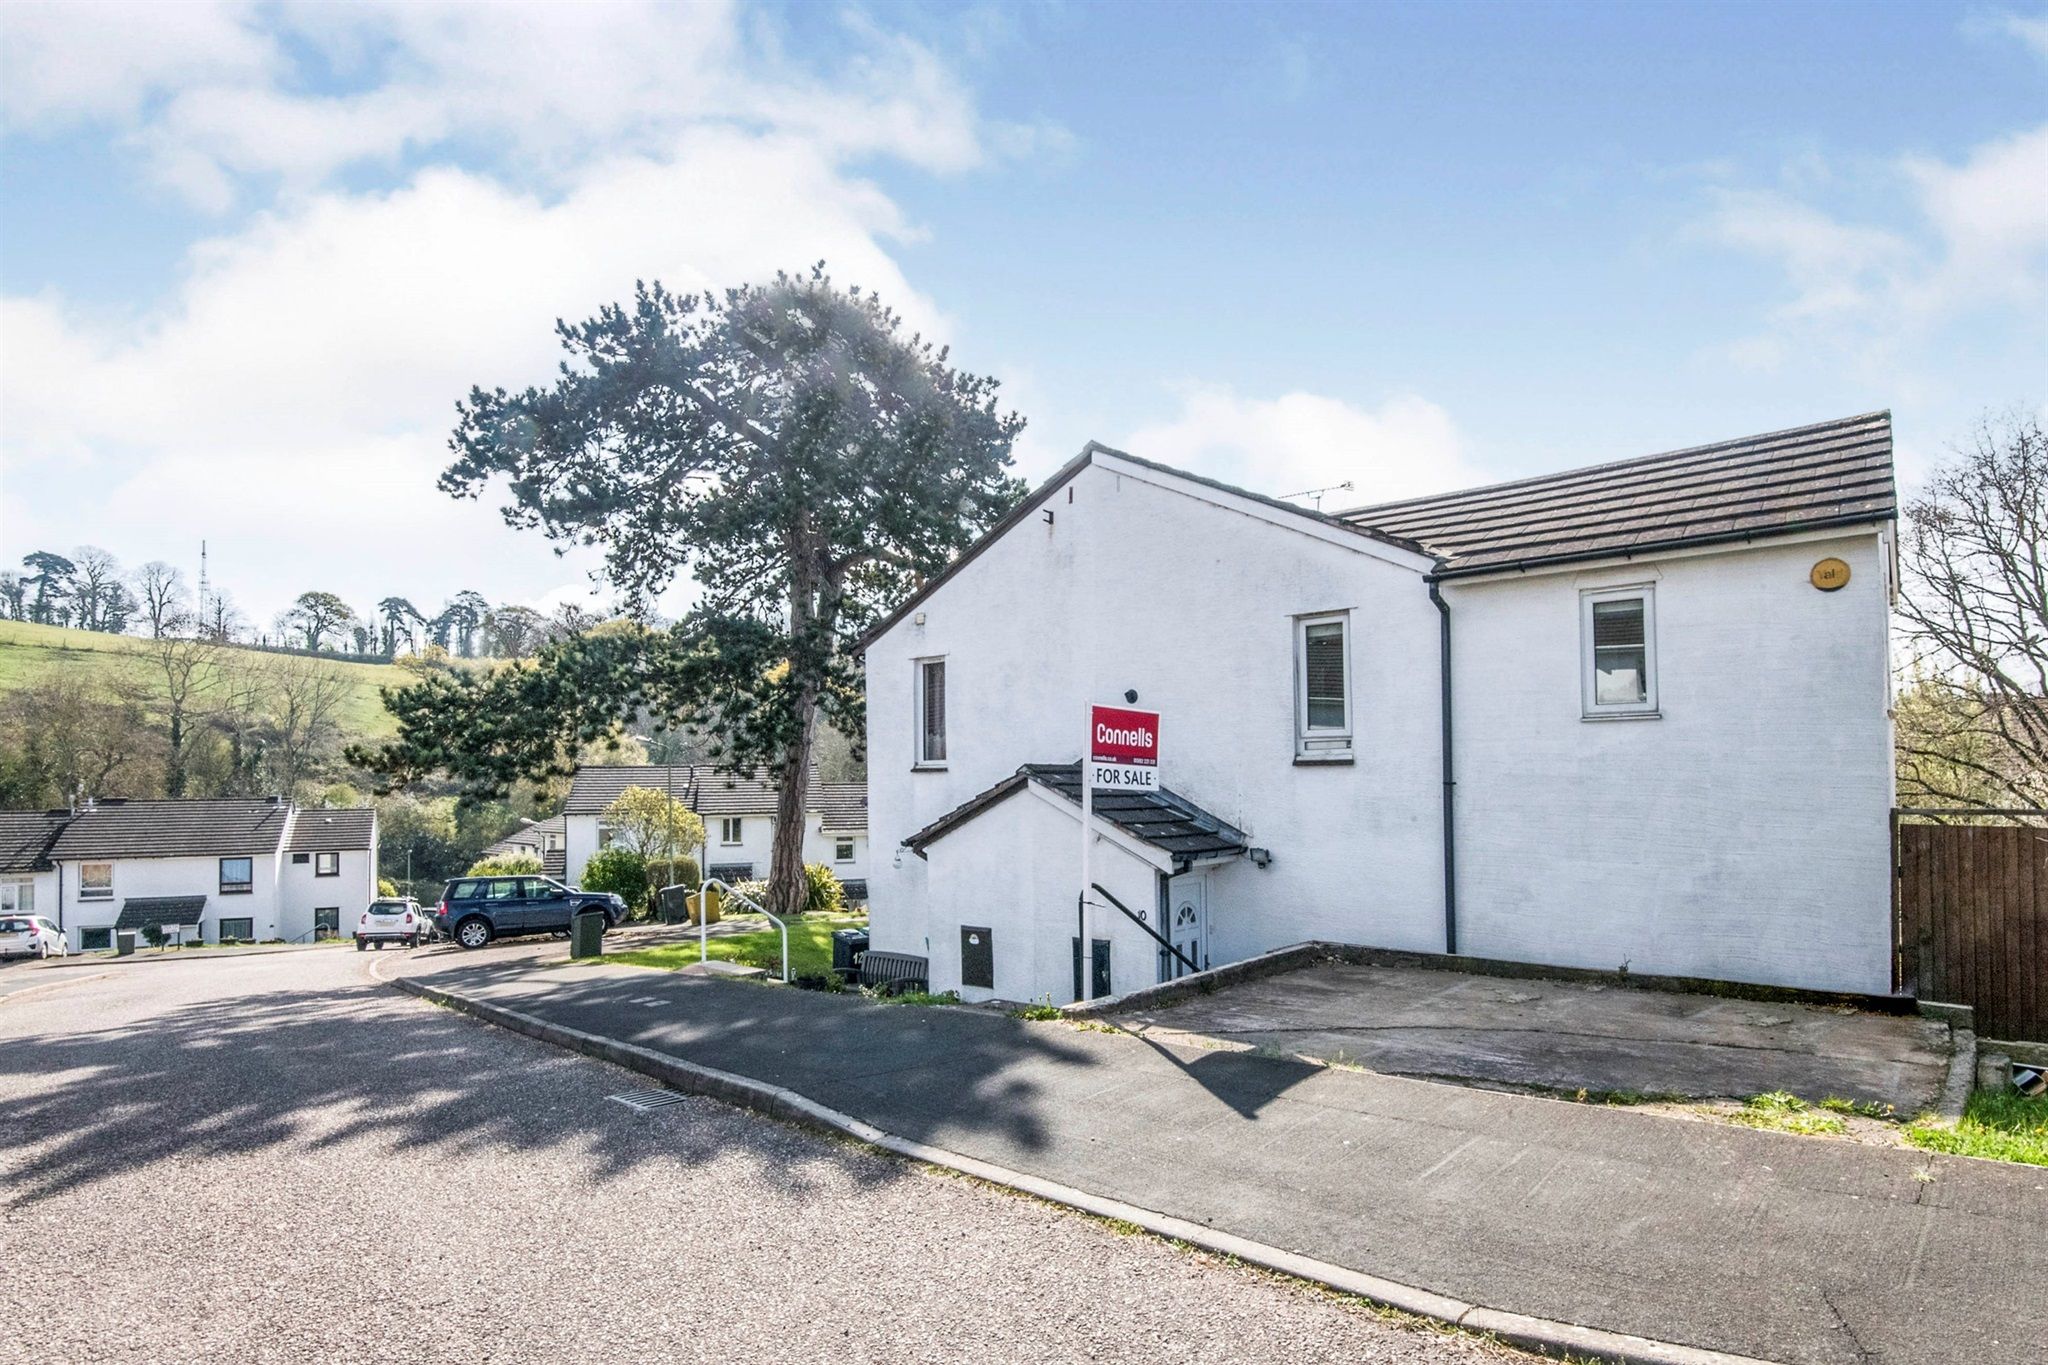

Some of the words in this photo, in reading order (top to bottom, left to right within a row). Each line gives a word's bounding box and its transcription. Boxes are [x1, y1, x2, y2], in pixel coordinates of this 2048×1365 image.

[1097, 723, 1153, 748] Connells
[1097, 768, 1120, 784] FOR
[1124, 770, 1151, 786] SALE
[1137, 909, 1147, 921] 10
